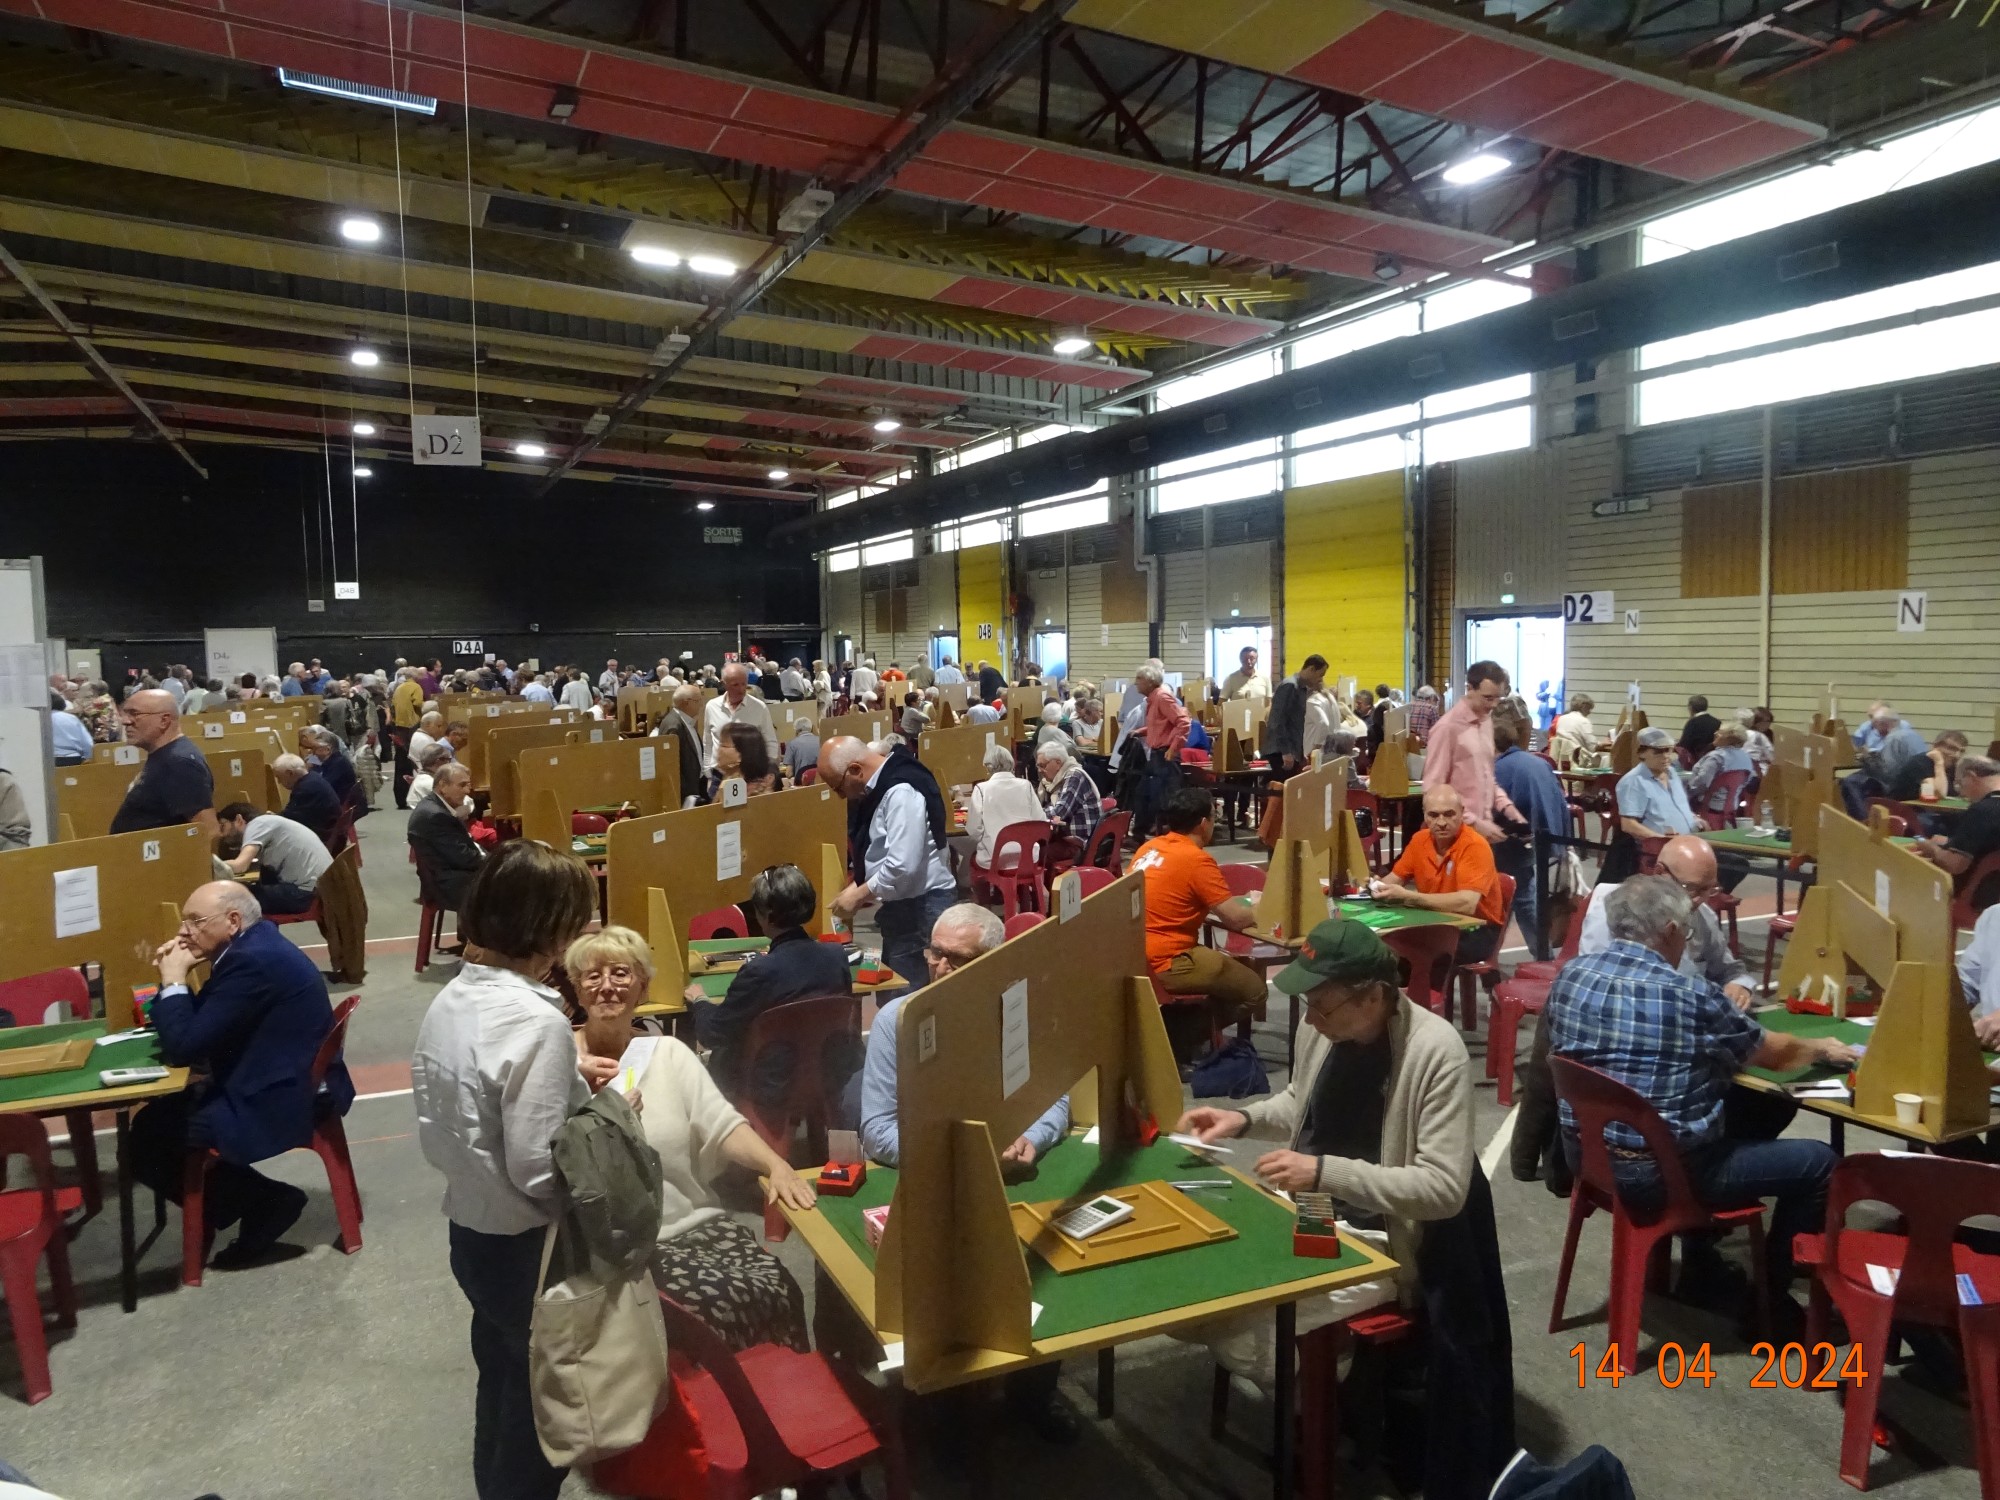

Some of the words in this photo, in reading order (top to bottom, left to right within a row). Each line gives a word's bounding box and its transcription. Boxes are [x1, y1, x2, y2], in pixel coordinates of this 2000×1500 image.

[427, 434, 464, 455] D2
[703, 527, 743, 536] SORTIE
[1563, 594, 1593, 622] D2
[1901, 597, 1923, 625] N
[1626, 612, 1638, 629] N
[978, 624, 992, 639] D4B
[1180, 625, 1188, 639] N
[454, 641, 482, 655] D4A
[124, 749, 129, 759] 1
[732, 783, 739, 797] 8
[147, 844, 156, 857] N
